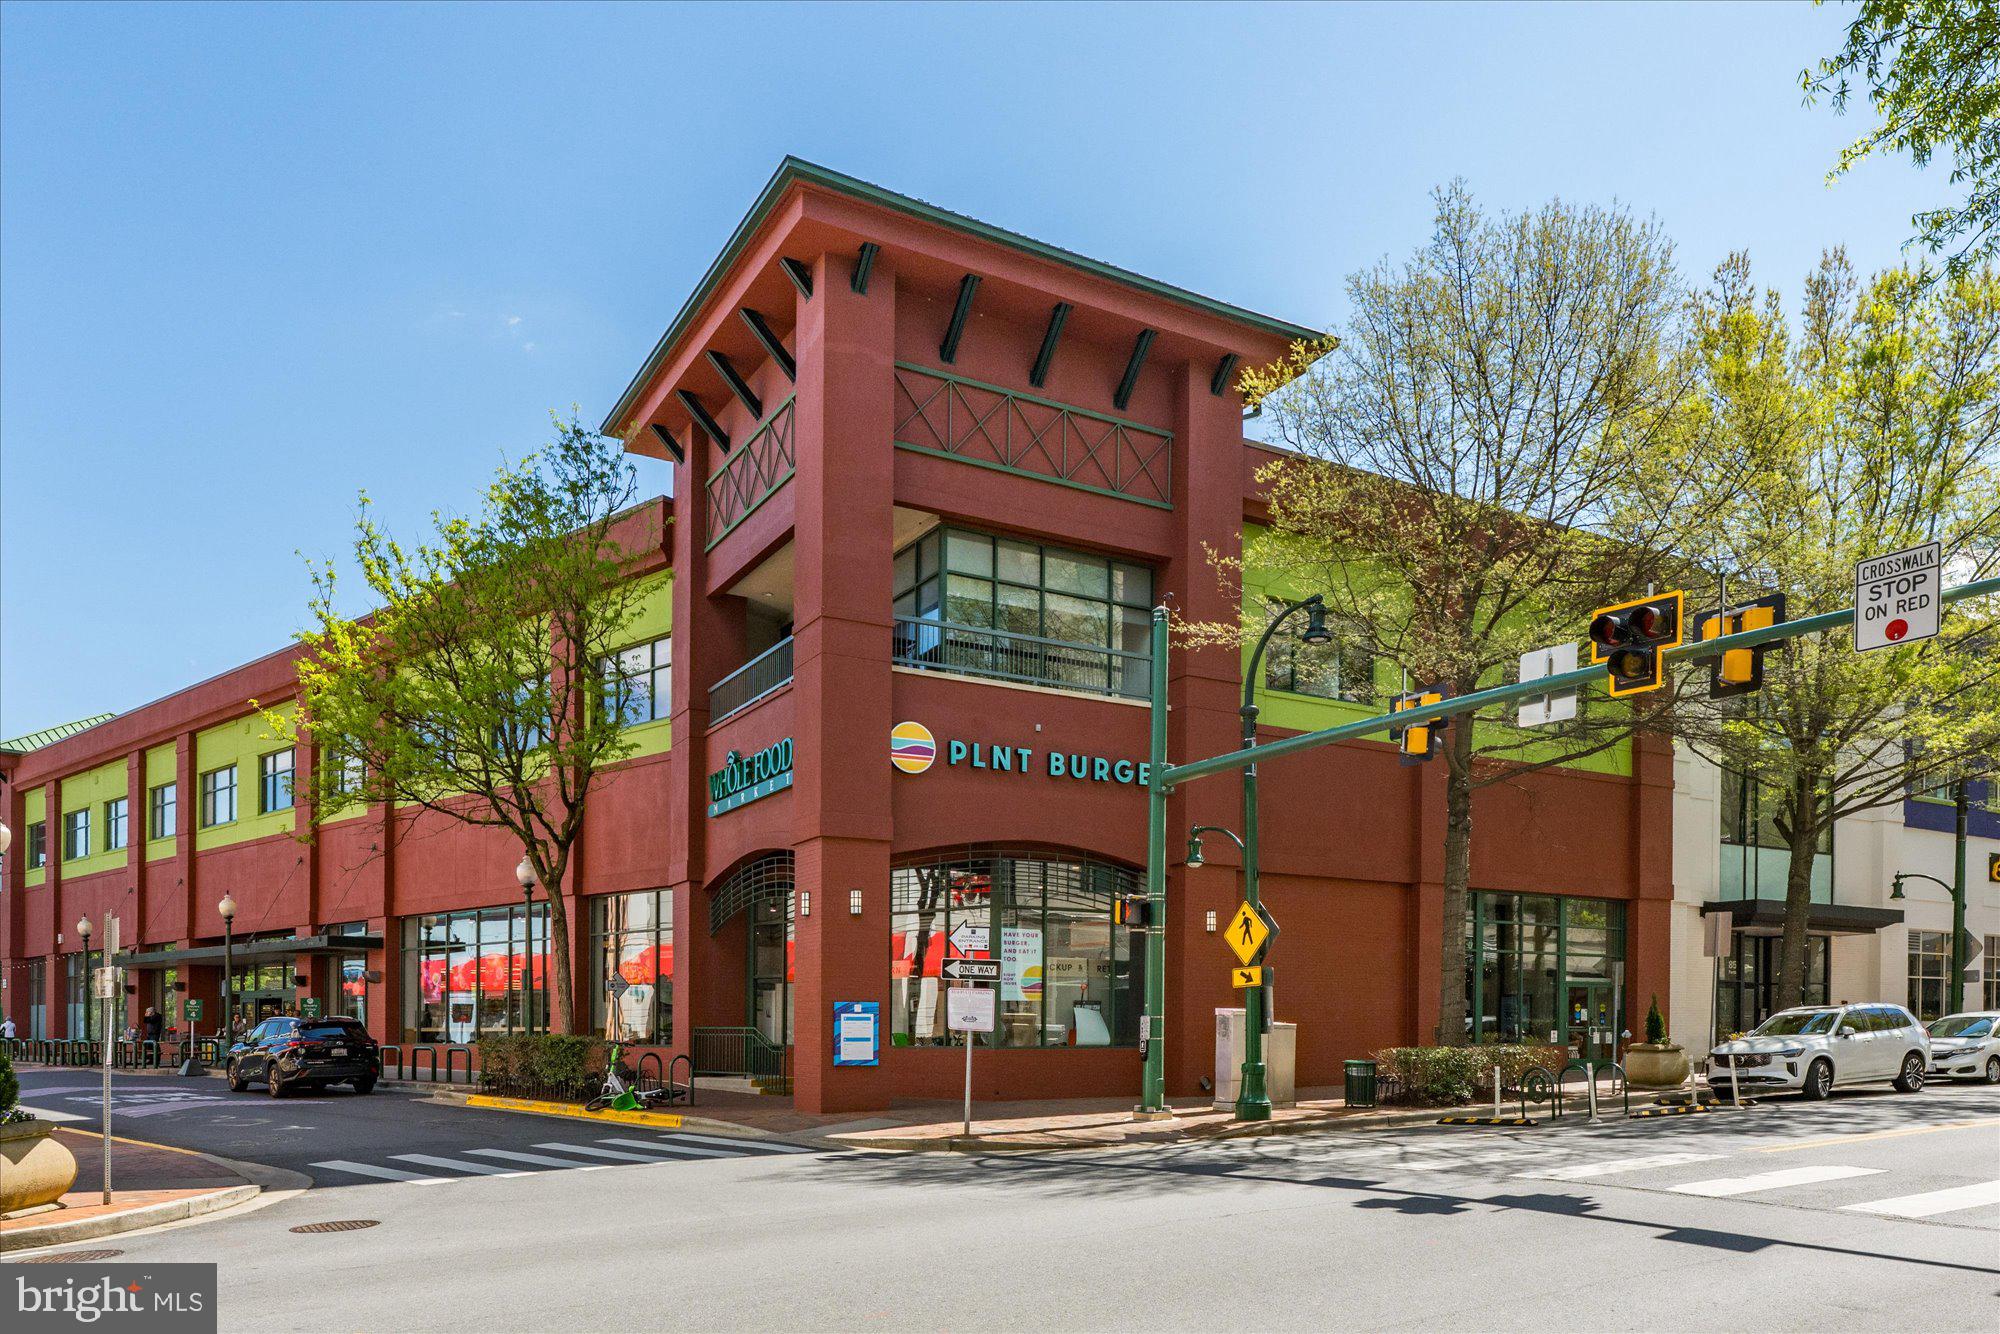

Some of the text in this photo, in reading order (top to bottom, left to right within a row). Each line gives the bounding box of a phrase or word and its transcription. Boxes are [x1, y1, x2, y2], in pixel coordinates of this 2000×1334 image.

[1862, 549, 1934, 581] CROSSWALK
[1868, 573, 1928, 602] STOP
[1865, 594, 1930, 621] ON RED
[709, 737, 793, 801] WHOLE FOOD
[949, 739, 1150, 786] PLNT BURGE
[713, 771, 791, 815] MARKET
[959, 965, 995, 974] ONE WAY
[1049, 963, 1073, 972] CKUP
[1096, 965, 1110, 973] RET
